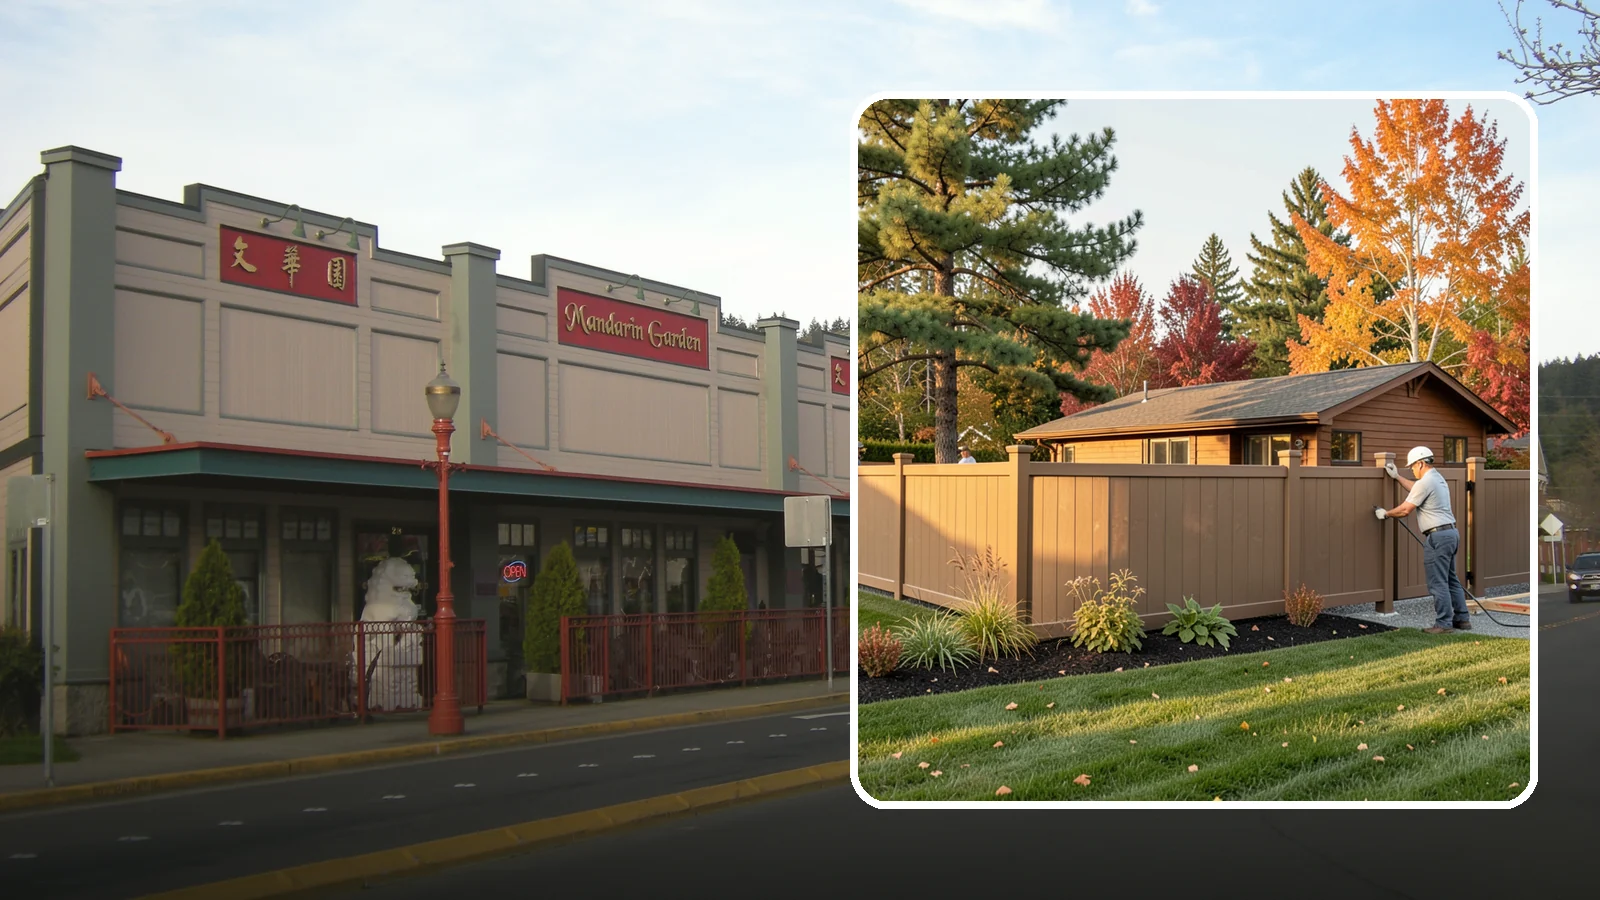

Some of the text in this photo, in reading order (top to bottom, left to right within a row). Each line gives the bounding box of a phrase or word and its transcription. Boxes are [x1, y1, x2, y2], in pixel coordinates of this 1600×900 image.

[230, 235, 347, 290] 文華園
[564, 302, 702, 352] Mandarin Garden
[503, 565, 527, 578] OPEN
